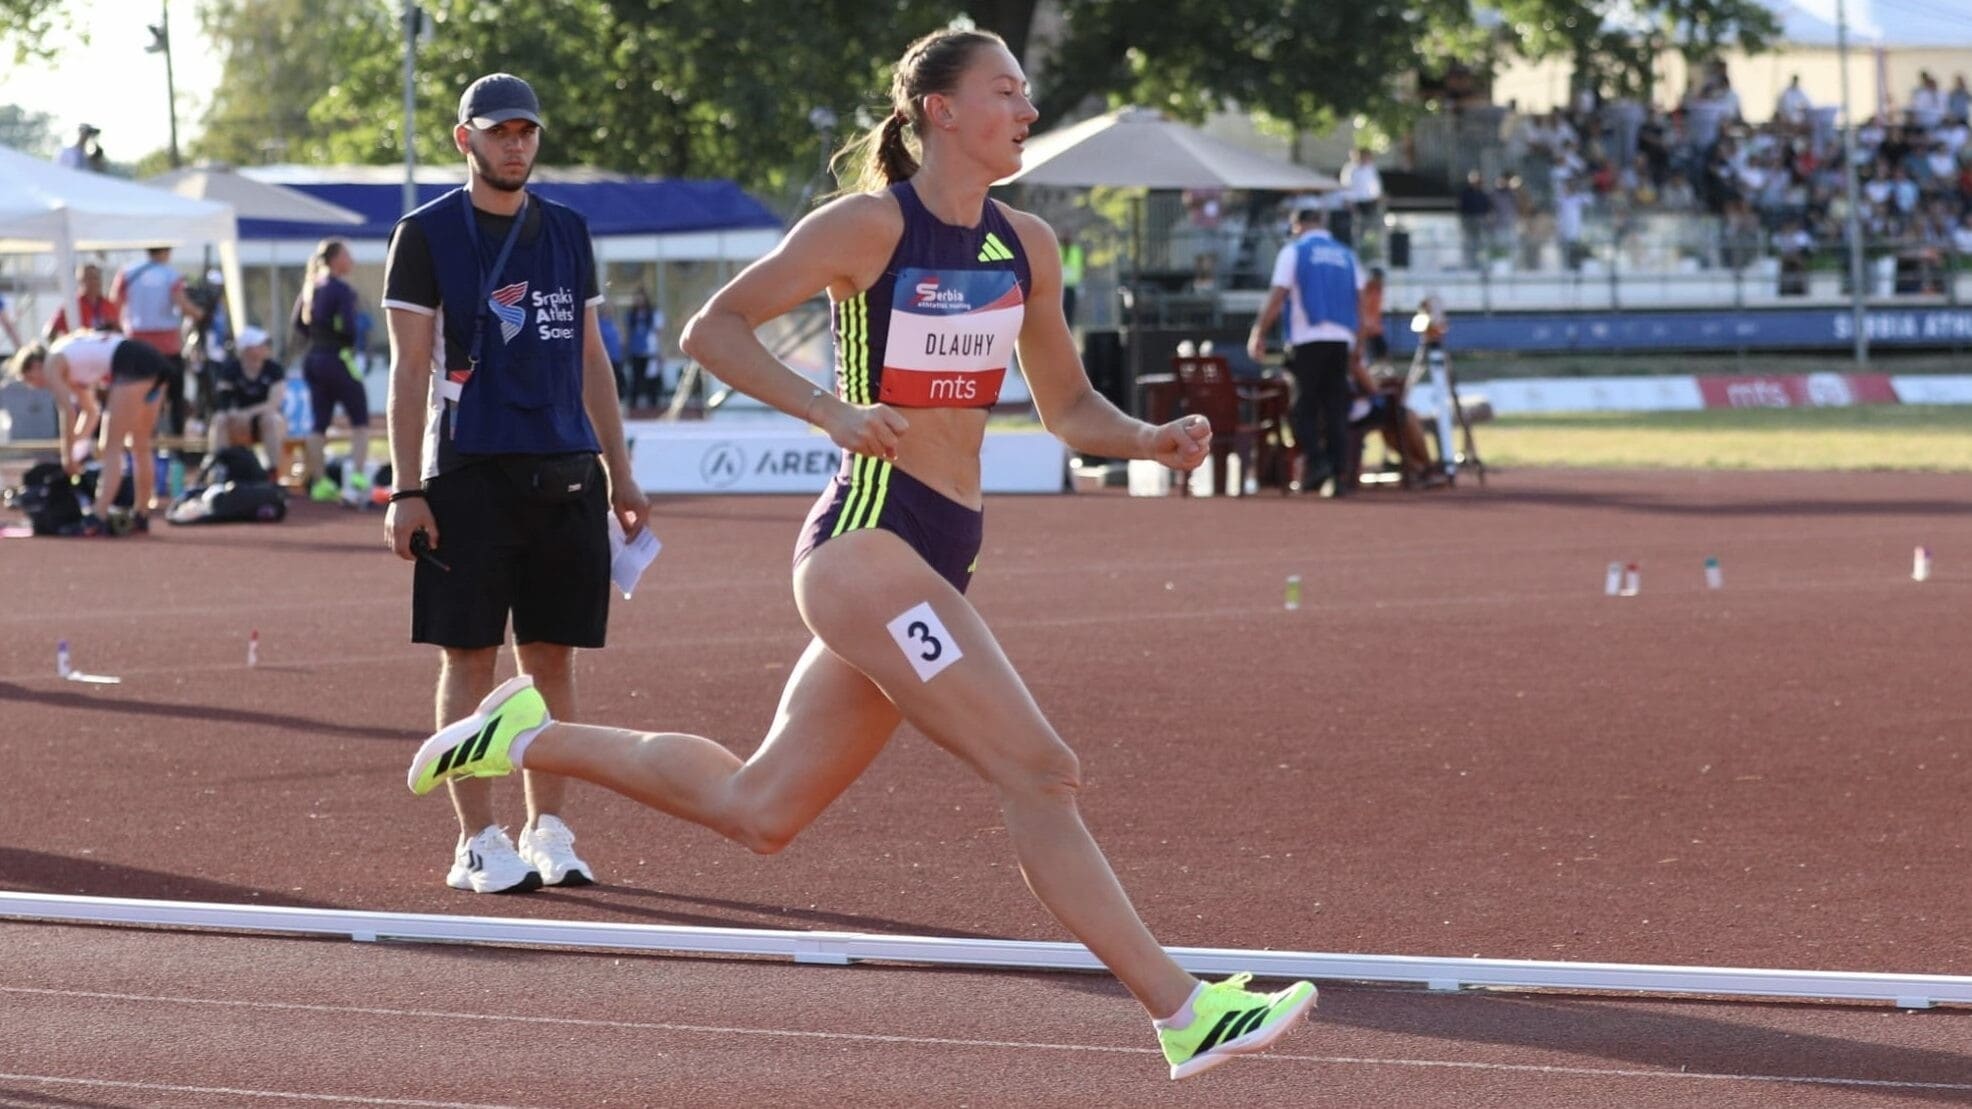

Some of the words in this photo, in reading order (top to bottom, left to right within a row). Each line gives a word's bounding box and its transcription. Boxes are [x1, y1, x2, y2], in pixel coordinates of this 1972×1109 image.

[916, 283, 965, 302] Serbia
[925, 333, 995, 356] DLAUHY
[929, 375, 977, 400] mts
[755, 451, 842, 474] AREN
[907, 620, 942, 662] 3
